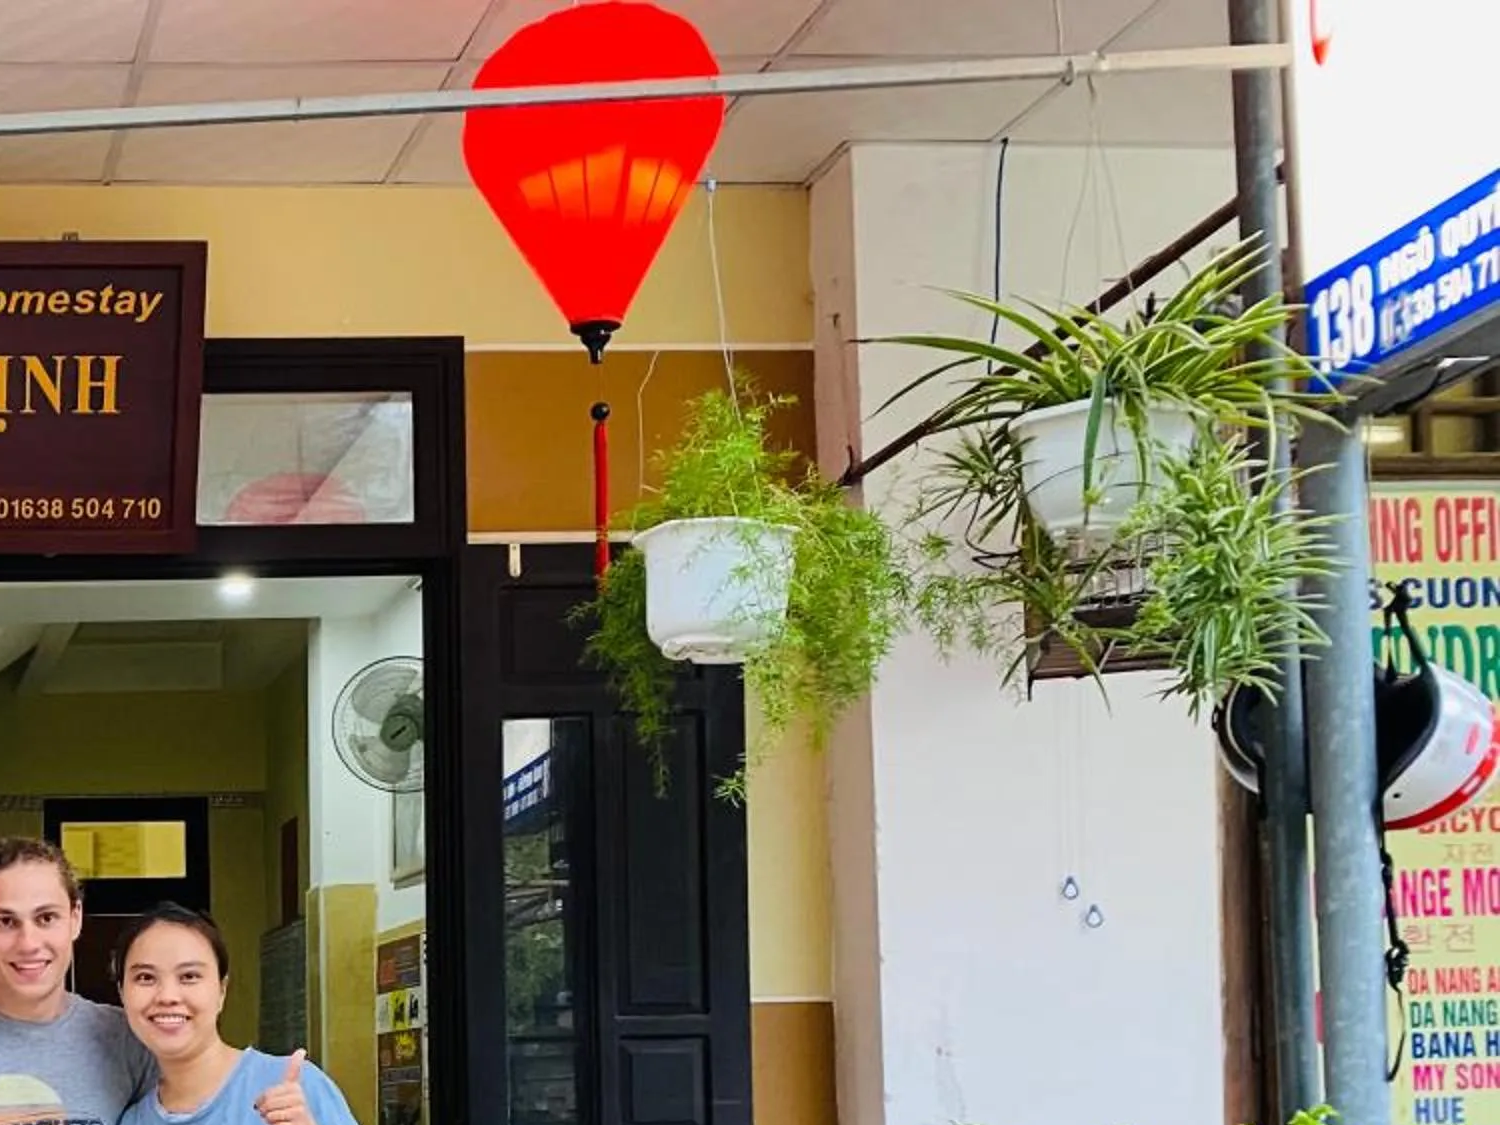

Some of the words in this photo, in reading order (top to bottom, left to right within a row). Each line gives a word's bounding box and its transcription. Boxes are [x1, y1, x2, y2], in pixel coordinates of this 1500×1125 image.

[1311, 265, 1376, 375] 138
[71, 497, 115, 520] 504
[121, 497, 162, 520] 710
[1435, 967, 1481, 994] NANG
[1409, 1001, 1437, 1028] DA
[1442, 999, 1498, 1026] NANG
[1411, 1031, 1477, 1059] BANA
[1412, 1063, 1447, 1091] MY
[1414, 1098, 1466, 1125] HUE
